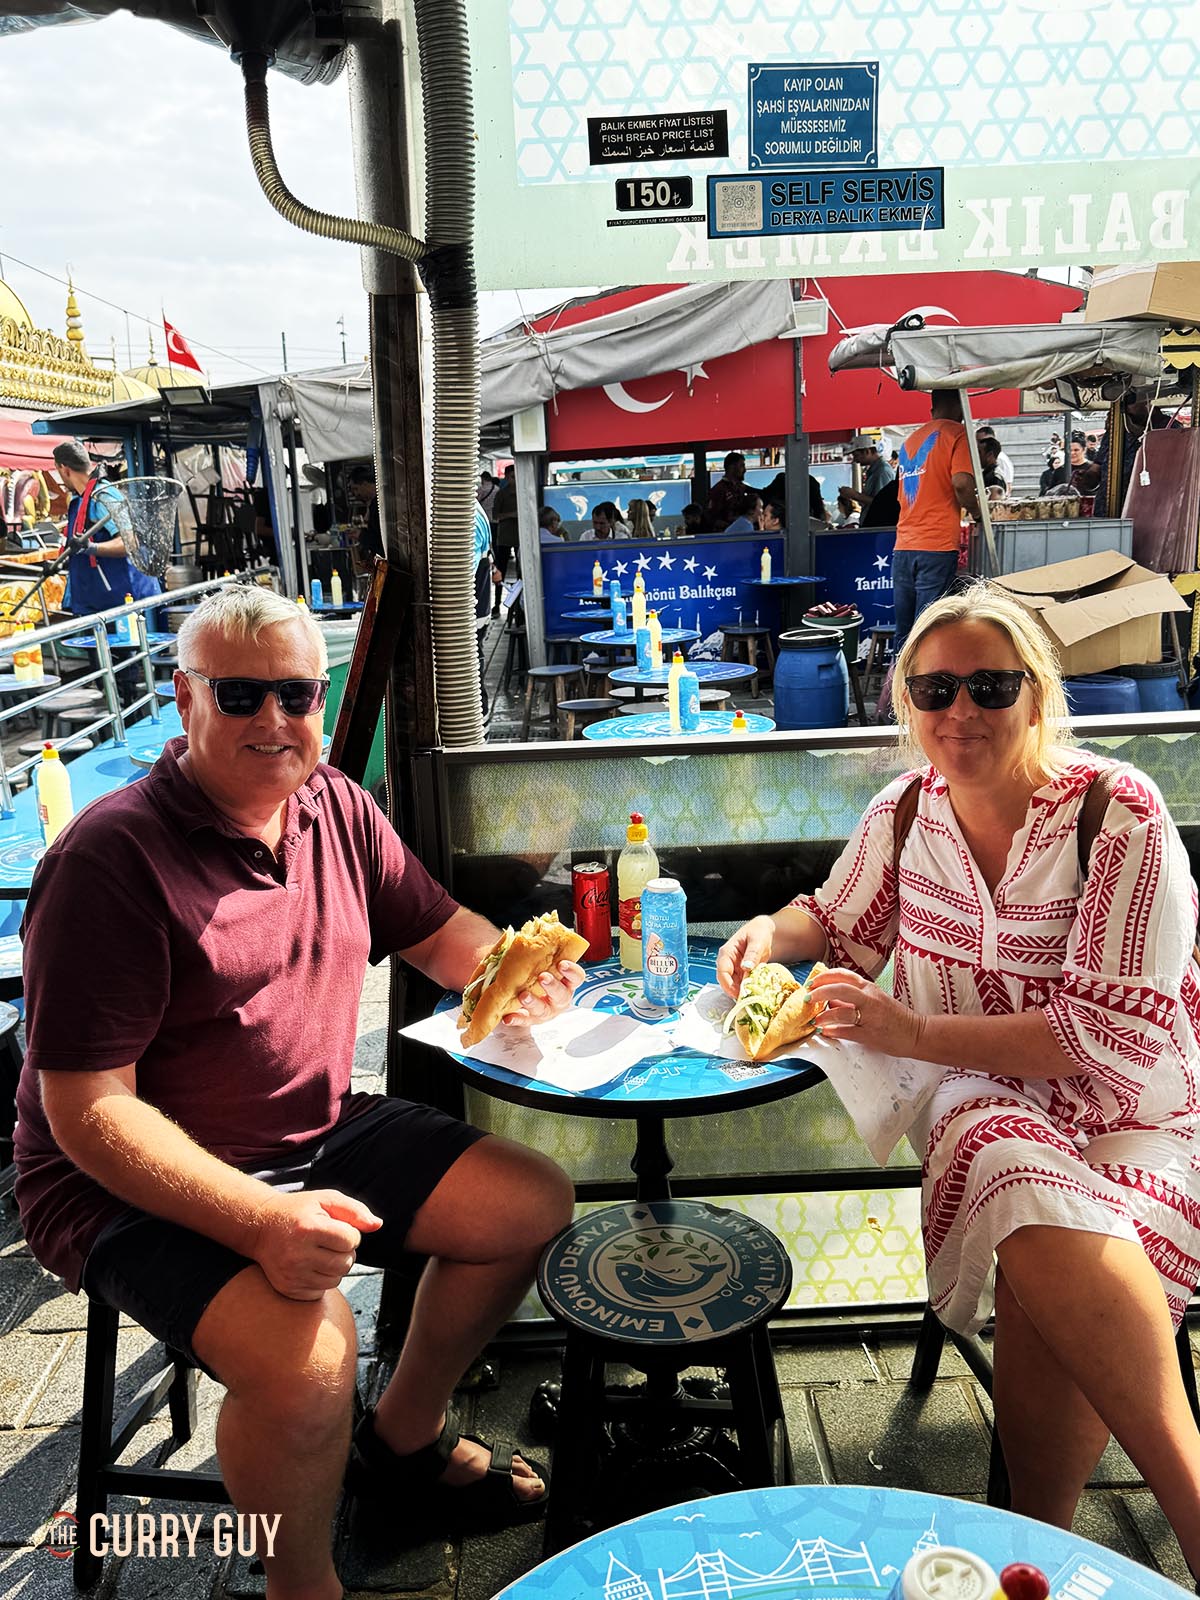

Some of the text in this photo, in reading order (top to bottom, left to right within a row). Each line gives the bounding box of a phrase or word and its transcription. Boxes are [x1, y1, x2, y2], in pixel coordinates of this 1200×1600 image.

[783, 77, 844, 92] KAYIP OLAN
[756, 96, 870, 118] ŞAHSİ EŞYALARINIZDAN
[600, 114, 714, 132] BALIK EKMEK FİYAT LİSTESİ
[780, 116, 846, 134] MÜESSESEMİZ
[601, 128, 715, 143] FISH BREAD PRICE LIST
[601, 145, 632, 158] السمك
[635, 144, 655, 159] خبز
[764, 136, 862, 155] SORUMLU DEĞİLDİR!
[769, 171, 936, 208] SELF SERVİS
[770, 210, 823, 227] DERYA
[826, 208, 876, 225] BALIK
[877, 205, 936, 223] EKMEK
[679, 584, 737, 601] Balıkçısı
[854, 576, 895, 591] Tarihi
[554, 1220, 665, 1332] EMİNÖNÜ DERYA
[741, 1253, 777, 1307] BALIK
